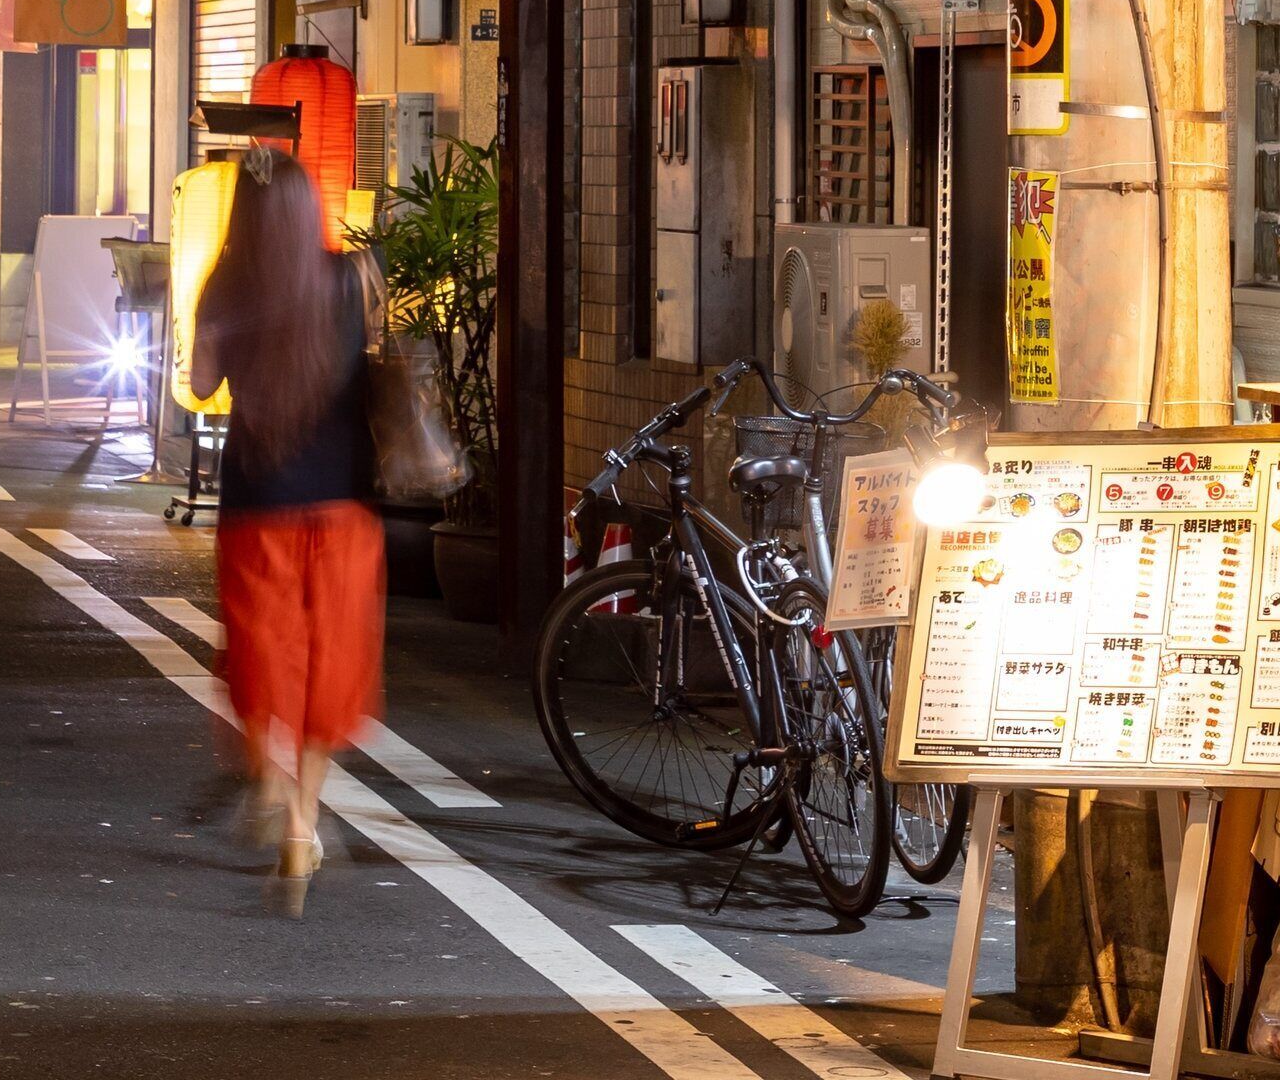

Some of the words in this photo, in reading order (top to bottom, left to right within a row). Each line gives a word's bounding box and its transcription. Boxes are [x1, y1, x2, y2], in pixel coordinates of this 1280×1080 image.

[1147, 452, 1212, 473] 一串入魂
[855, 471, 916, 491] アルバイト
[858, 495, 900, 514] スタッフ
[864, 516, 894, 542] 募集
[939, 591, 965, 604] あて
[1014, 591, 1073, 604] 逸品料理
[1103, 638, 1143, 651] 和牛串
[1005, 662, 1066, 675] 野菜サラダ
[1088, 693, 1146, 706] 焼き野菜
[996, 725, 1061, 736] 付き出しキャベツ
